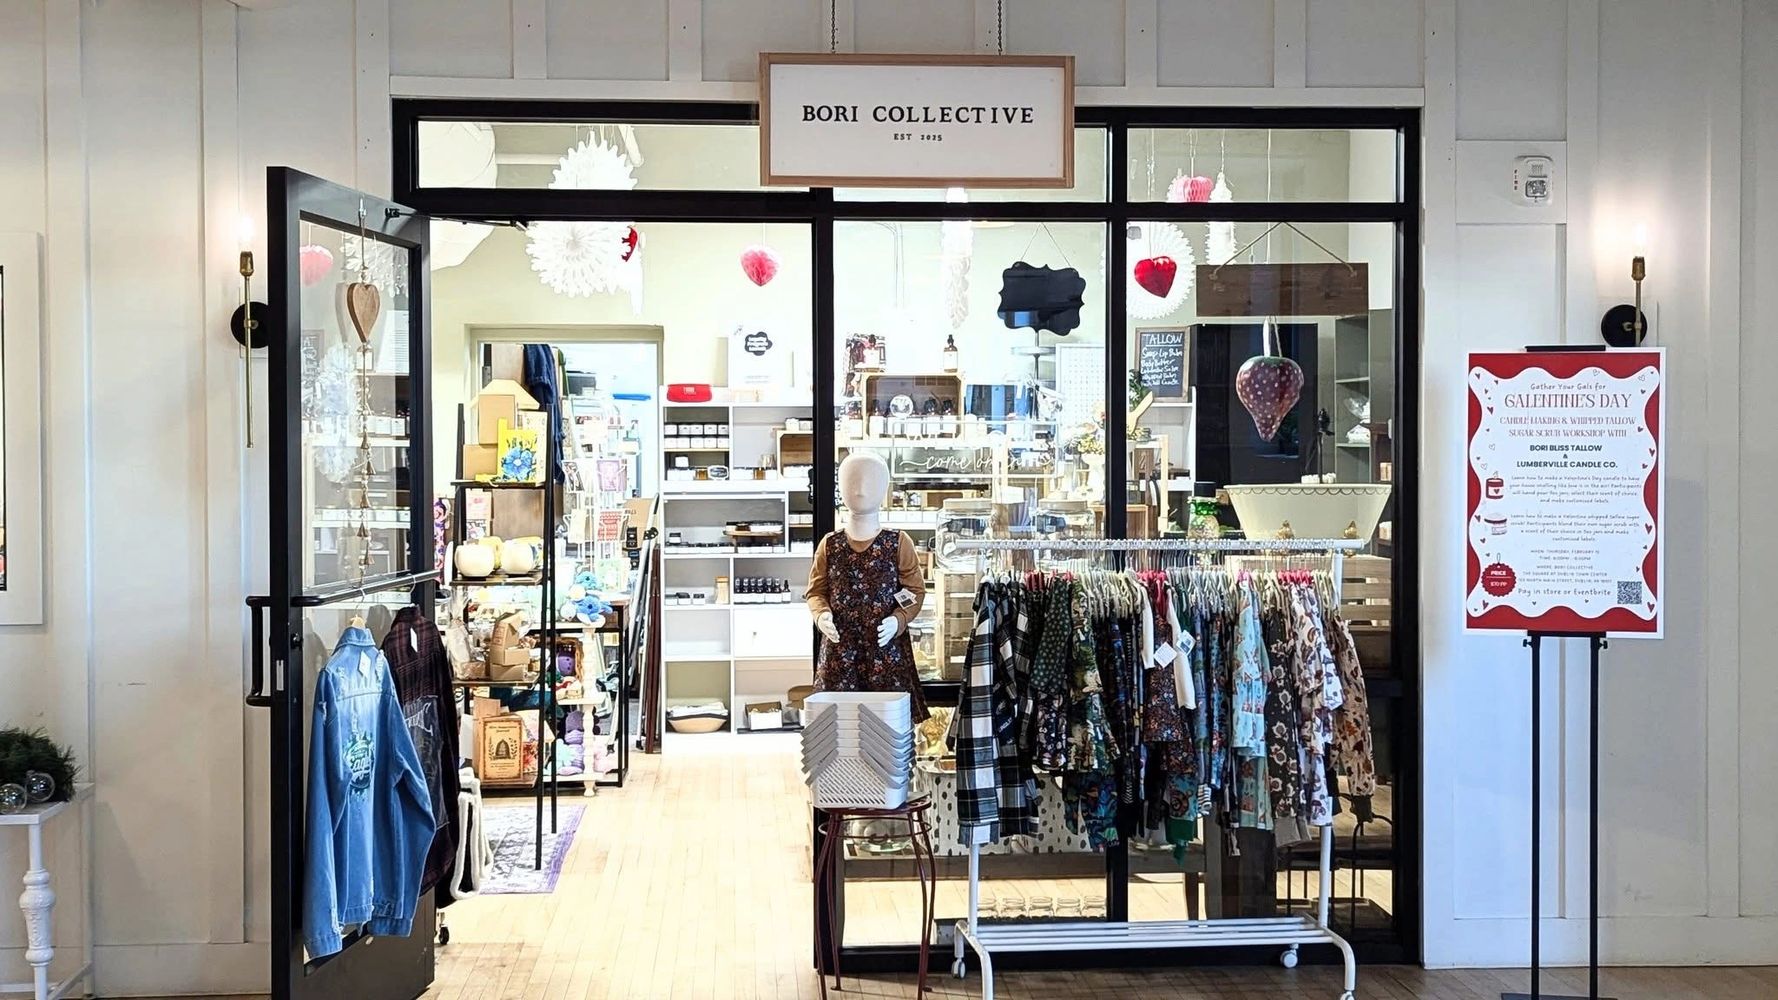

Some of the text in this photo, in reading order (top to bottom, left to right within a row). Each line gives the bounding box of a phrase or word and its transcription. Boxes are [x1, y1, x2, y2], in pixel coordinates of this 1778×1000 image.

[802, 105, 1034, 124] BORI COLLECTIVE
[1142, 333, 1183, 344] TALLOW
[1595, 382, 1606, 392] for
[1600, 393, 1632, 408] DAY
[1605, 417, 1636, 425] TALLOW
[1508, 429, 1534, 437] SUGAR
[1536, 429, 1560, 437] SCRUB
[1562, 429, 1606, 437] WORKSHOP
[925, 455, 971, 470] come
[1518, 588, 1531, 597] Pay
